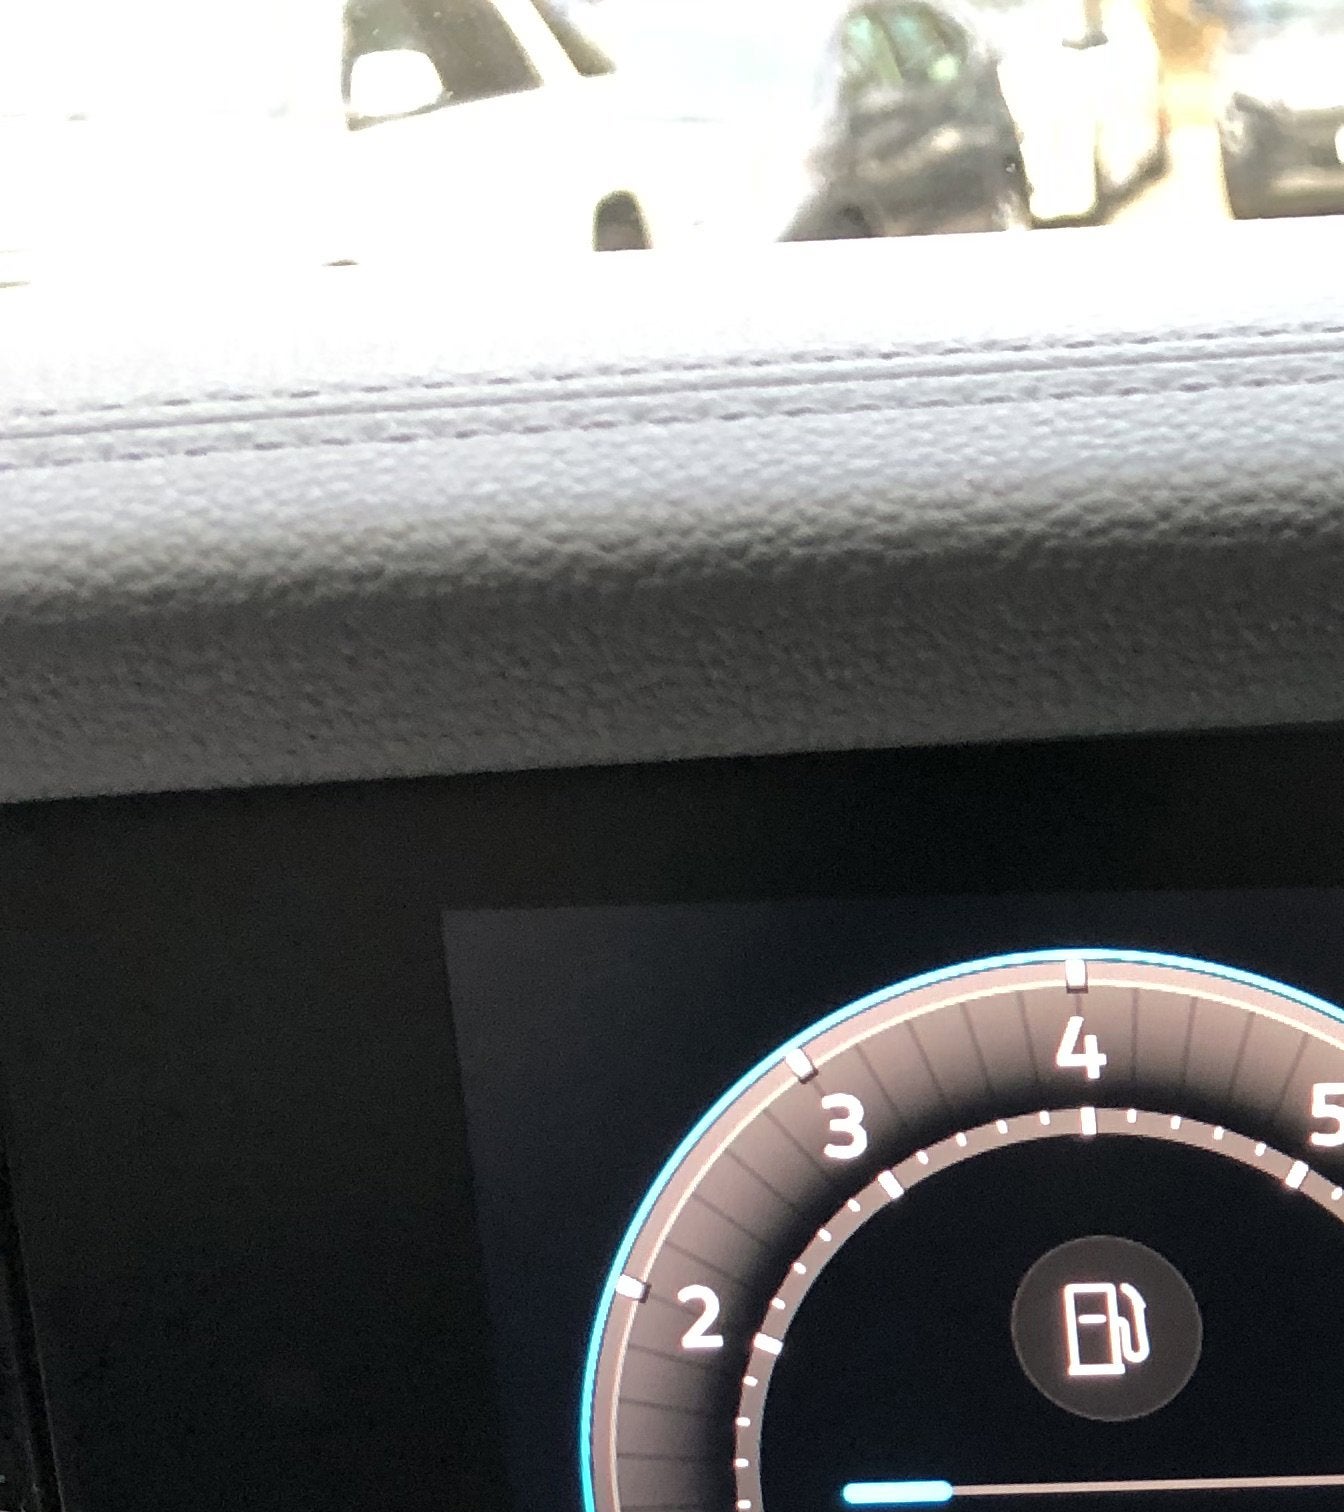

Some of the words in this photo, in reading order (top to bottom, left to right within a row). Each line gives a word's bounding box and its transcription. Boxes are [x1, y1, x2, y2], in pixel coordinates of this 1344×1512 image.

[1055, 1015, 1107, 1080] 4
[819, 1093, 869, 1160] 3
[671, 1283, 725, 1351] 2
